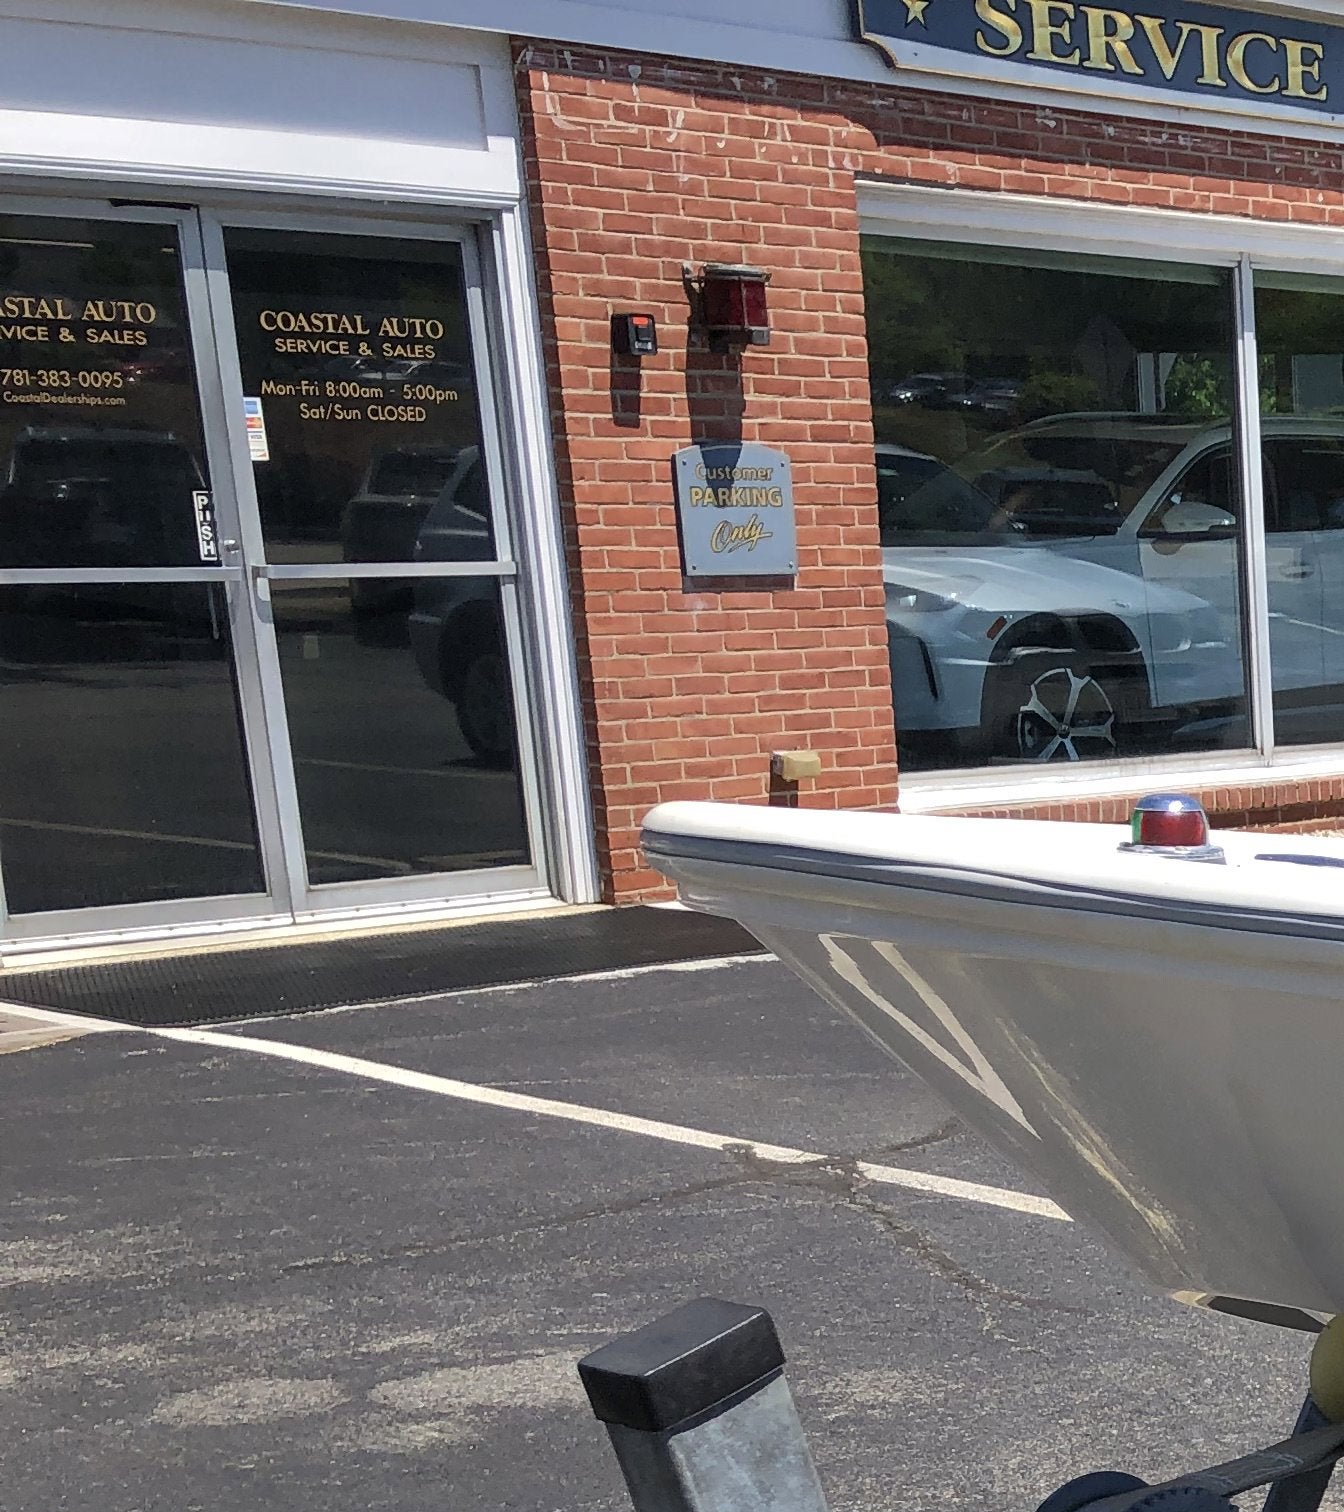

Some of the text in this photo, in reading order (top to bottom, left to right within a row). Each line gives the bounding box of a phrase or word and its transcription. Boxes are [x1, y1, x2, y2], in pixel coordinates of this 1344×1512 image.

[975, 0, 1328, 102] SERVICE
[81, 300, 157, 324] AUTO
[0, 325, 148, 346] VICE & SALES
[259, 310, 444, 340] COASTAL AUTO
[274, 338, 436, 359] SERVICE & SALES
[1, 368, 124, 389] 781-383-0095
[3, 391, 126, 407] CoastalDealerships.com
[261, 379, 320, 397] Mon-Fri
[325, 381, 384, 399] 8:00am
[402, 384, 459, 404] 5:00pm
[300, 402, 427, 422] Sat/Sun CLOSED
[694, 462, 774, 482] Customer
[689, 485, 784, 508] PARKING
[197, 494, 216, 556] PUSH
[711, 513, 774, 554] Only
